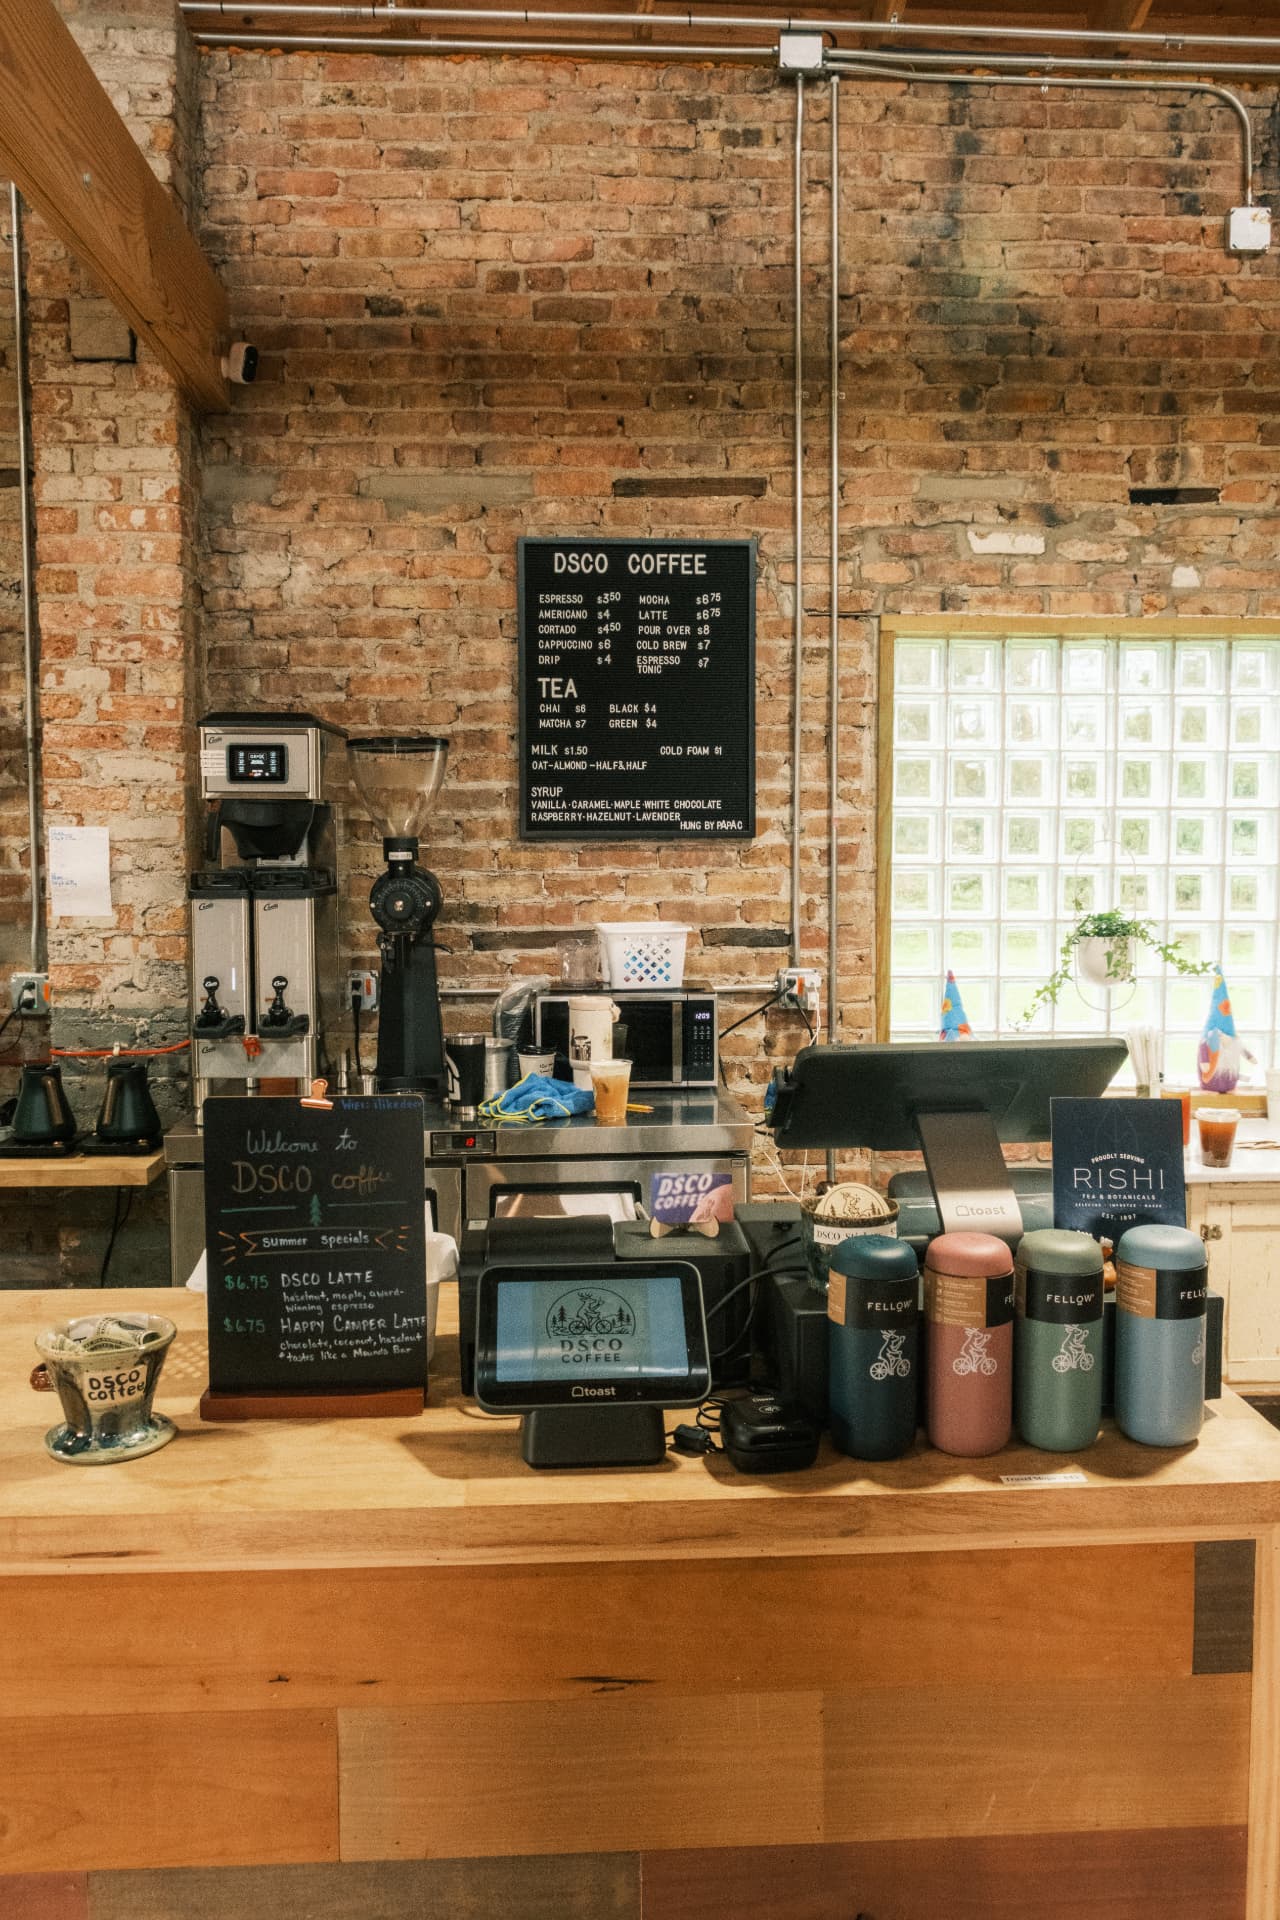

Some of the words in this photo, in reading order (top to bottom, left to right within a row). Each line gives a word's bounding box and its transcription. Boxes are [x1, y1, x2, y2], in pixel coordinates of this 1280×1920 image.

[553, 553, 608, 574] DSCO
[628, 554, 707, 574] COFFEE
[539, 594, 583, 604] ESPRESSO
[639, 595, 670, 605] MOCHA
[538, 610, 588, 619] AMERICANO
[597, 609, 610, 619] $4
[639, 611, 668, 620] LATTE
[538, 625, 576, 634] CORTADO
[638, 626, 661, 635] POUR
[666, 626, 691, 635] OVER
[697, 625, 710, 635] $8
[538, 640, 593, 649] CAPPUCCINO
[636, 641, 659, 650] COLD
[663, 641, 687, 650] BREW
[697, 640, 711, 650] $7
[538, 656, 560, 664] DRIP
[597, 655, 611, 665] $4
[636, 656, 680, 665] ESPRESSO
[698, 657, 709, 669] $7
[637, 665, 662, 674] TONIC
[537, 677, 578, 698] TEA
[539, 704, 560, 713] CHAI
[609, 704, 639, 713] BLACK
[644, 703, 656, 713] $4
[539, 719, 571, 728] MATCHA
[575, 720, 586, 728] $7
[609, 719, 638, 728] GREEN
[646, 718, 657, 728] $4
[531, 745, 558, 755] MILK
[660, 746, 682, 755] COLD
[687, 747, 709, 755] FOAM
[531, 786, 563, 797] SYRUP
[674, 800, 722, 809] CHOCOLATE
[680, 821, 701, 830] HUNG
[704, 821, 714, 830] BY
[247, 1129, 318, 1154] Welcome
[336, 1128, 358, 1150] to
[231, 1161, 312, 1193] DSCO
[1073, 1167, 1164, 1190] RISHI
[658, 1174, 713, 1196] DSCO
[654, 1192, 707, 1210] COFFEE
[970, 1206, 1006, 1216] toast
[262, 1237, 308, 1248] summer
[320, 1231, 369, 1248] specials
[816, 1230, 841, 1241] DSCO
[224, 1275, 269, 1291] $6.75
[281, 1273, 320, 1288] DSCO
[328, 1271, 373, 1285] LATTE
[332, 1291, 367, 1301] maple,
[1046, 1294, 1092, 1306] FELLOW
[331, 1303, 375, 1311] espresso
[867, 1301, 911, 1312] FELLOW
[223, 1317, 265, 1333] $6.75
[560, 1338, 623, 1352] DSCO
[561, 1353, 622, 1364] COFFEE
[88, 1370, 140, 1390] DSCO
[88, 1382, 145, 1401] coffee
[584, 1386, 616, 1397] toast
